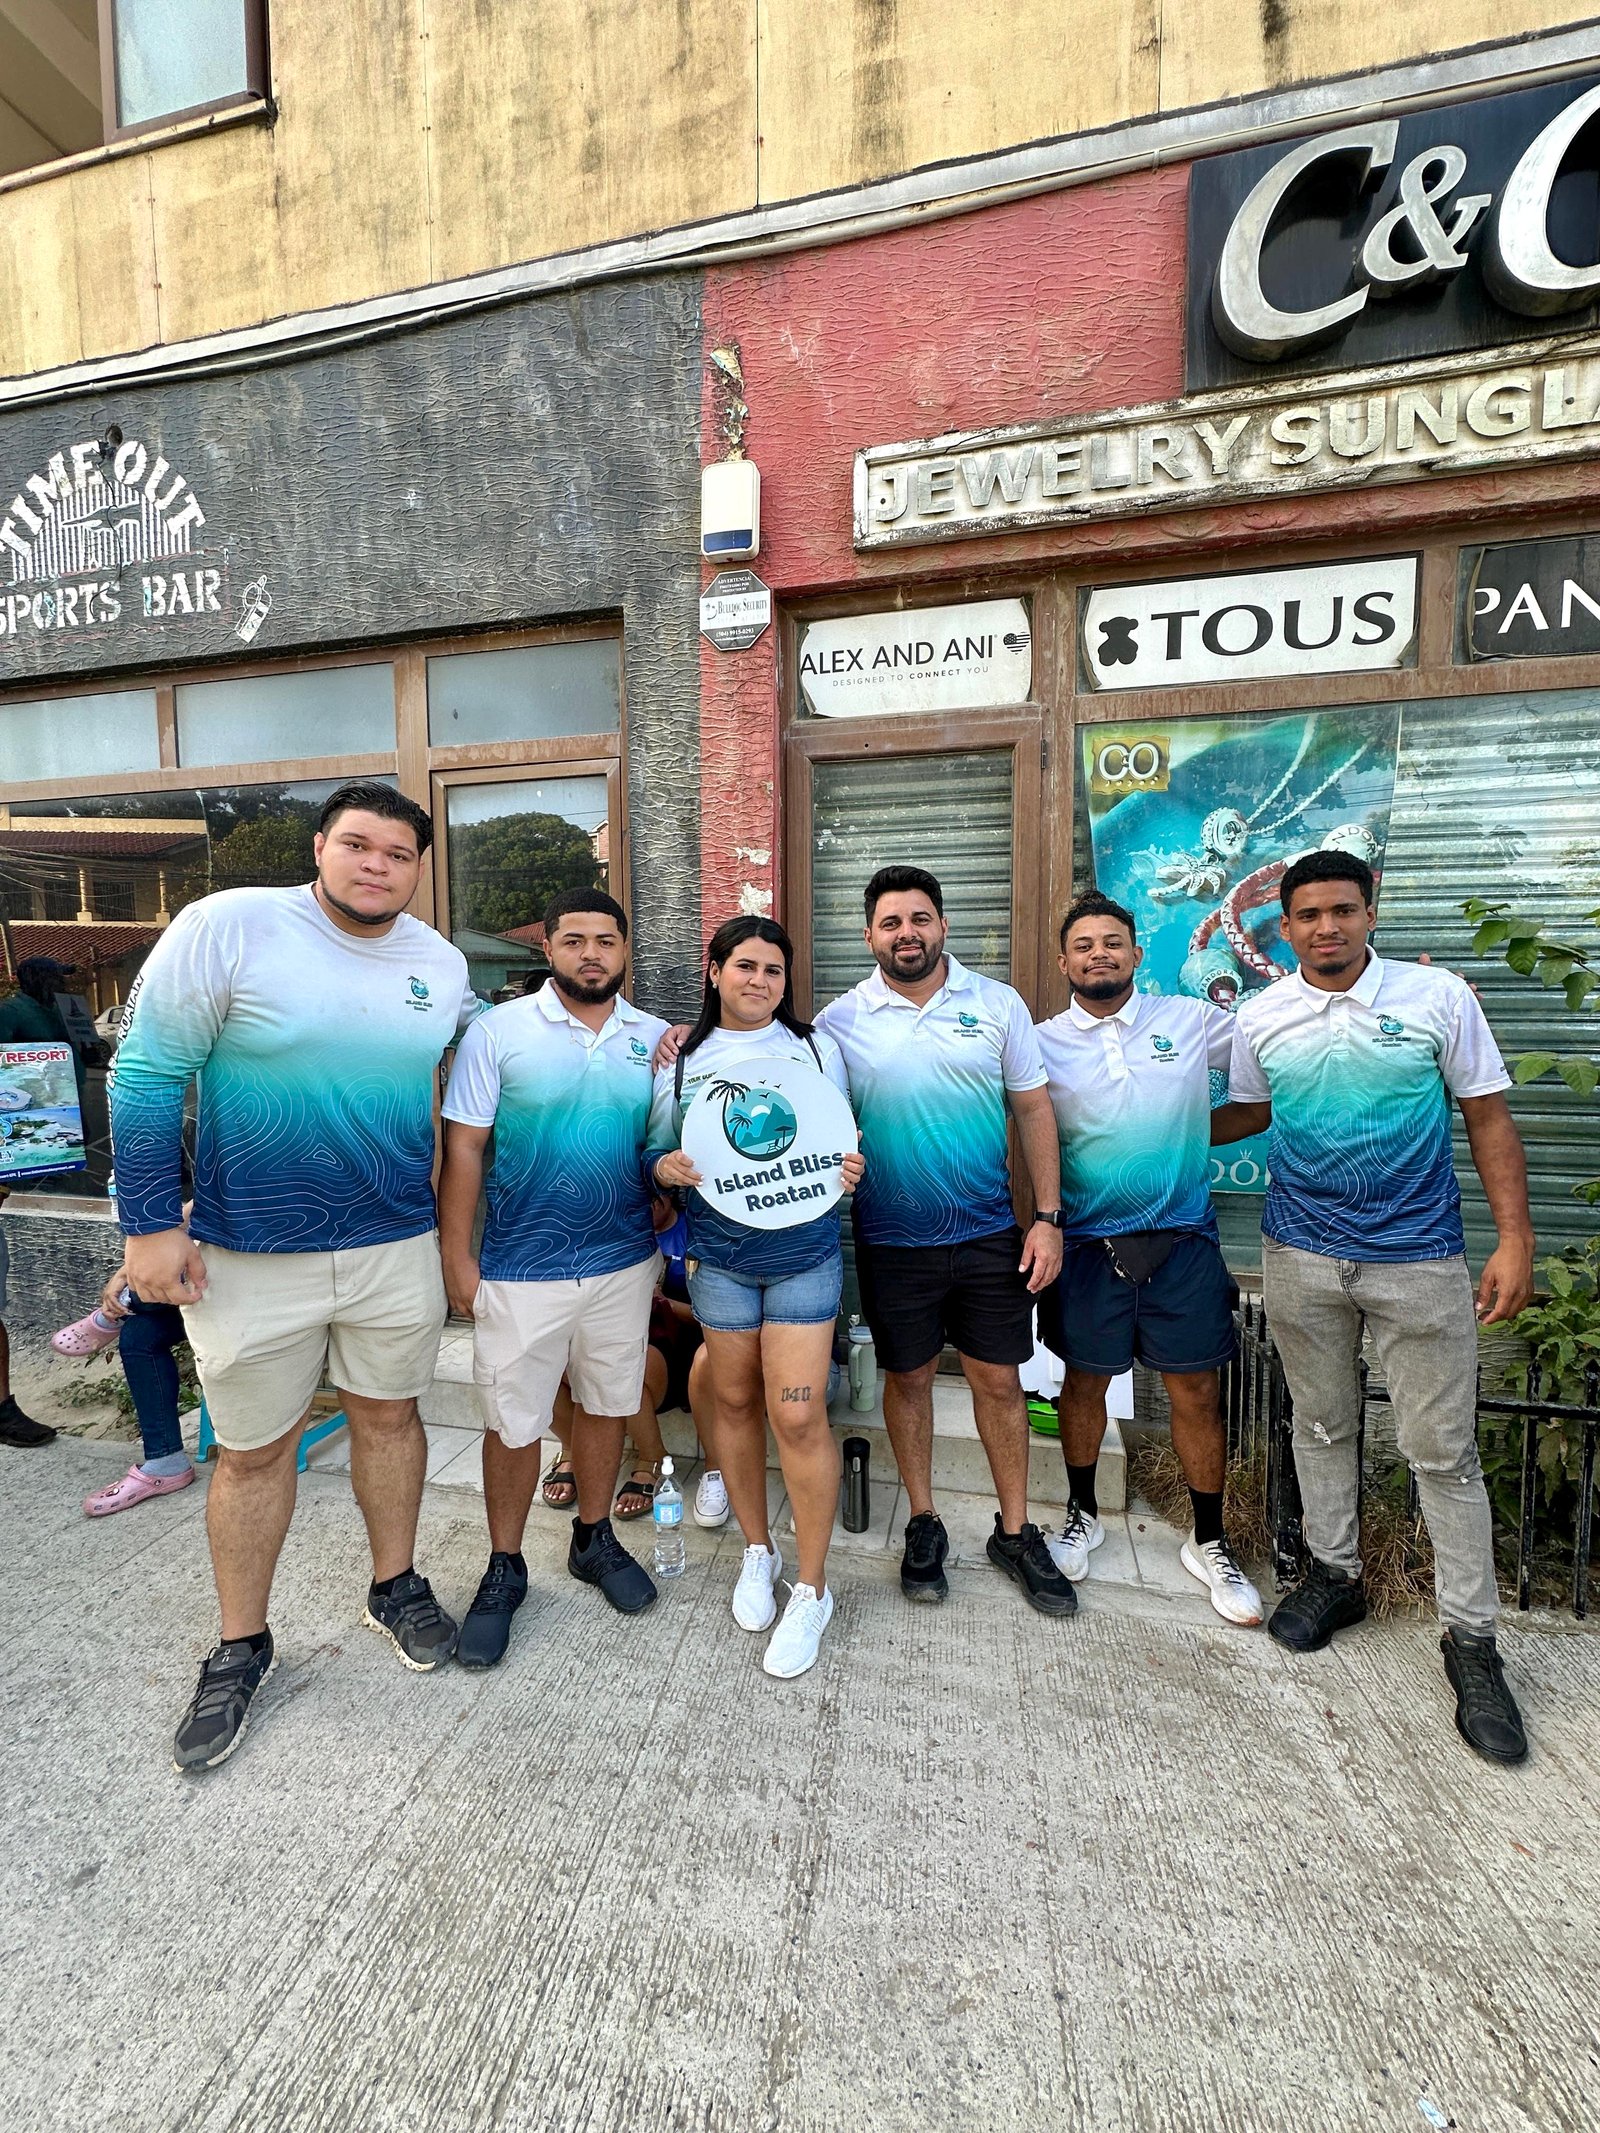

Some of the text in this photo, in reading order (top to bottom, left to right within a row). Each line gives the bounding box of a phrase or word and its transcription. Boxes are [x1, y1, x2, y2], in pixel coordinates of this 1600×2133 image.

[876, 367, 1600, 523] JEWELRY SUNGL
[0, 440, 206, 558] TIME OUT
[142, 569, 222, 617] BAR
[1150, 591, 1397, 661] TOUS
[800, 635, 993, 676] ALEX AND ANI
[833, 666, 989, 687] DESIGNED TO CONNECT YOU
[5, 1050, 68, 1063] RESORT
[714, 1152, 843, 1195] Island Bliss
[745, 1181, 827, 1212] Roatan
